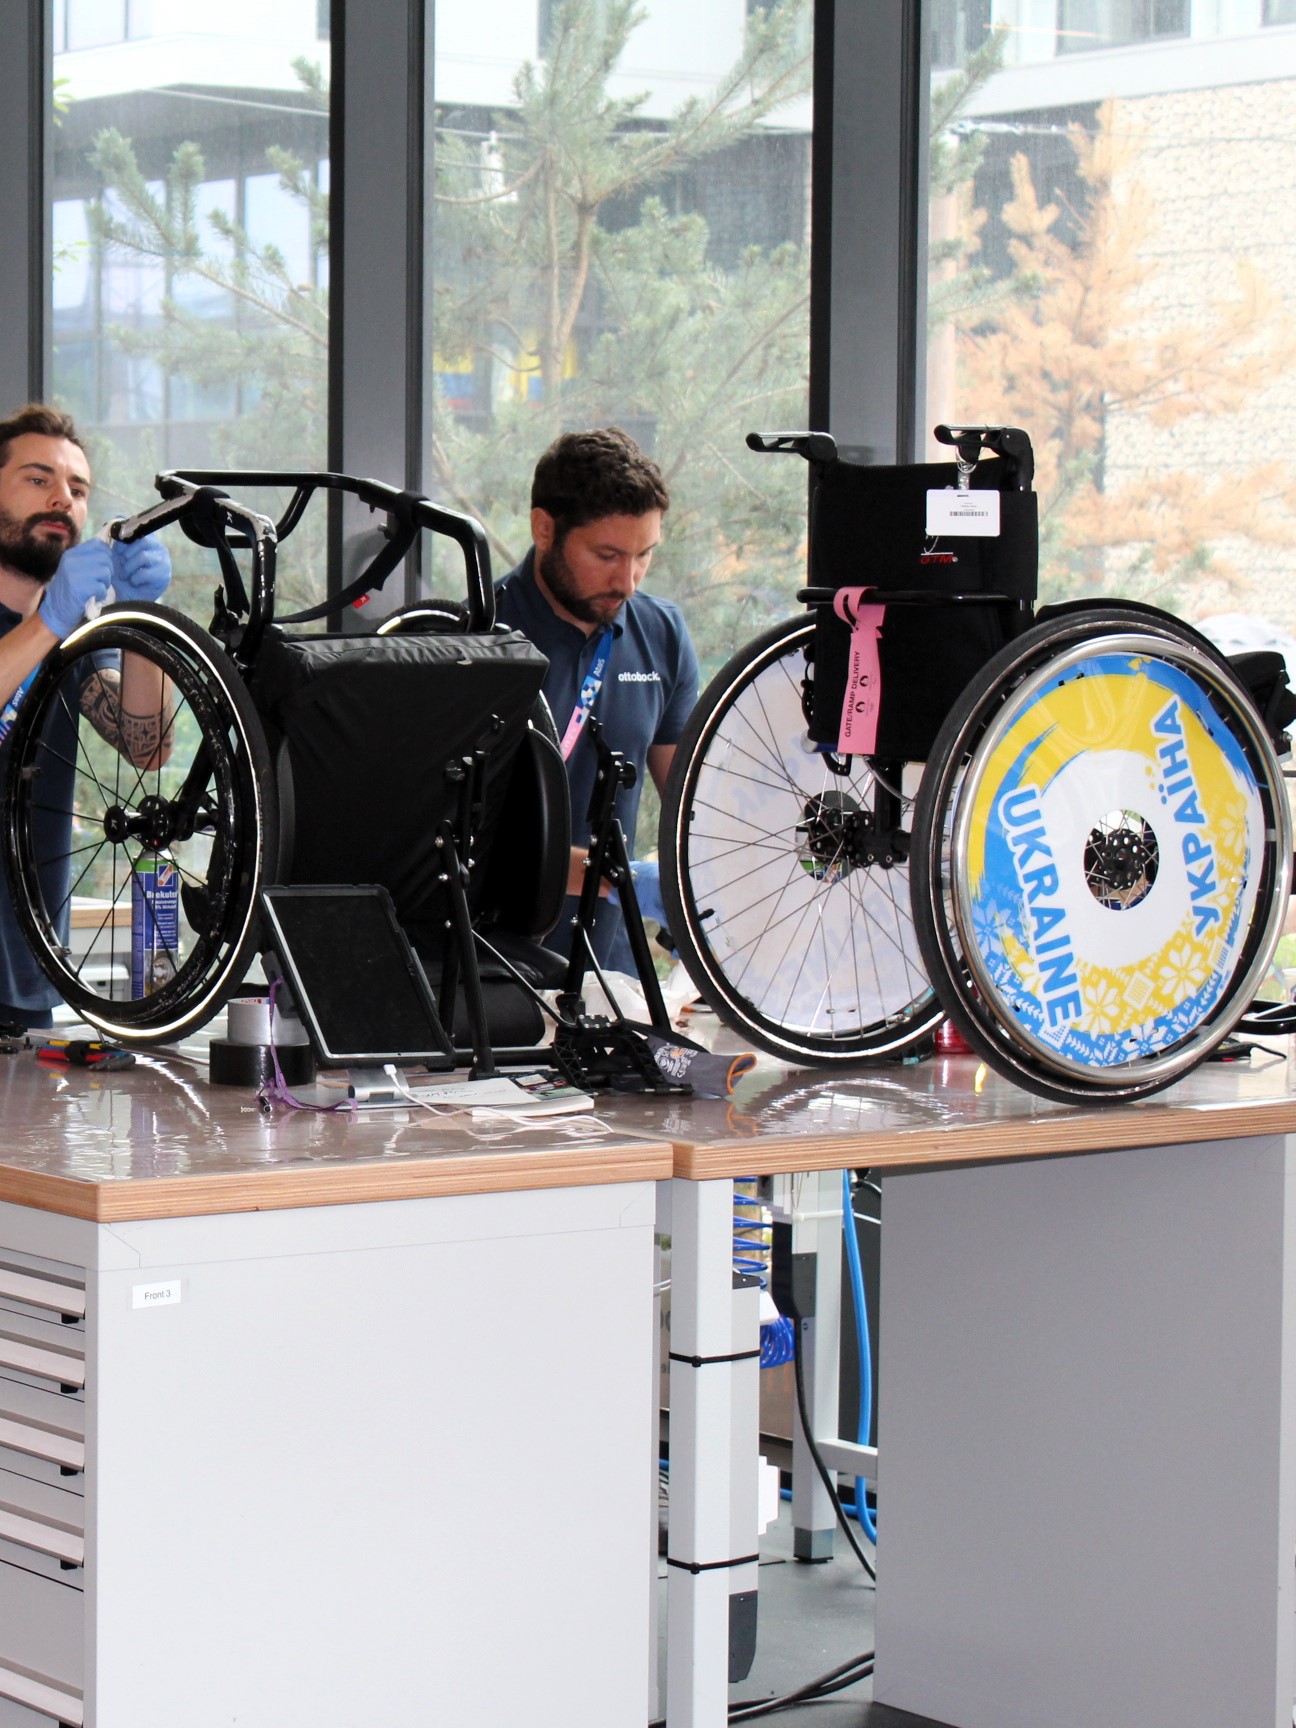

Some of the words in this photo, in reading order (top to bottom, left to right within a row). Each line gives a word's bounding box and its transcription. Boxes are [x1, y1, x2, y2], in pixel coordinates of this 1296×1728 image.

[845, 691, 856, 738] GATE/RAMP
[851, 651, 860, 690] DELIVERY
[1153, 699, 1221, 937] УКРАЇНА
[1002, 787, 1082, 1028] UKRAINE
[144, 1290, 165, 1301] Front
[166, 1289, 172, 1298] 3
